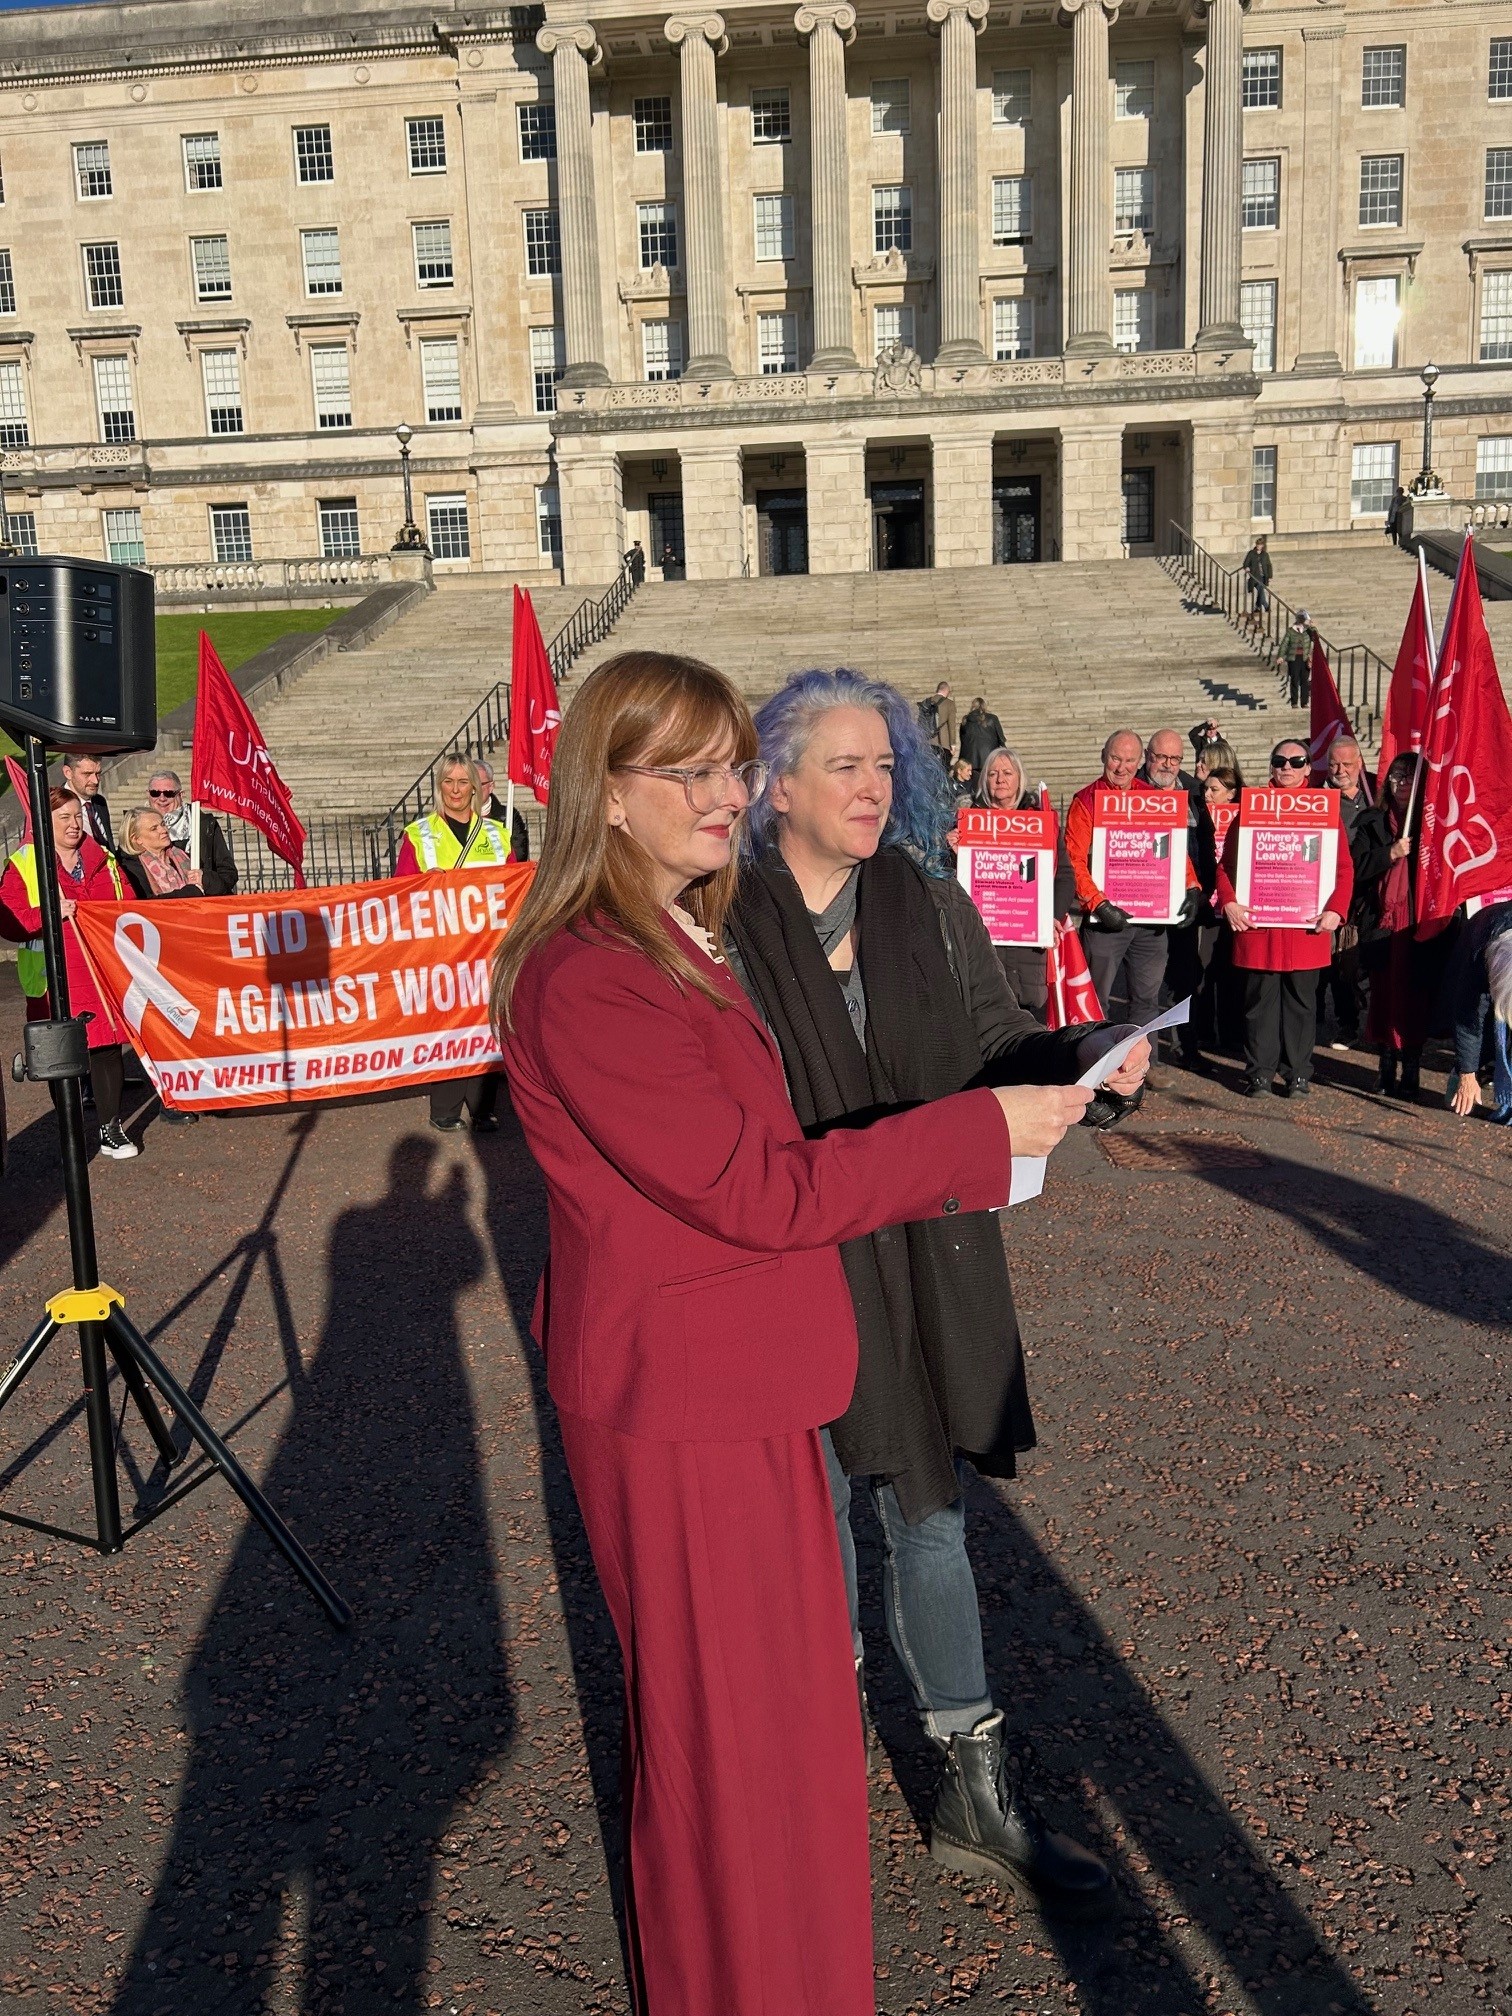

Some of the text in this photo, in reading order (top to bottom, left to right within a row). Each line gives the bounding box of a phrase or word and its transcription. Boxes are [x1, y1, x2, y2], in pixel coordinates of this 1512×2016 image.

[1102, 791, 1177, 821] nipsa
[1250, 790, 1328, 821] nipsa
[967, 811, 1043, 841] nipsa
[1110, 830, 1150, 840] Where's
[1256, 832, 1299, 842] Where's
[1109, 840, 1152, 850] Our Safe
[1256, 842, 1302, 852] Our Safe
[975, 851, 1016, 862] Where's
[1109, 849, 1146, 858] Leave?
[1256, 851, 1294, 861] Leave?
[975, 861, 1019, 871] Our Safe
[975, 870, 1012, 880] Leave?
[228, 883, 508, 959] END VIOLENCE
[215, 958, 490, 1036] AGAINST WOM
[161, 1069, 205, 1092] DAY
[213, 1061, 297, 1089] WHITE
[306, 1047, 404, 1080] RIBBON
[413, 1035, 500, 1064] CAMPA
